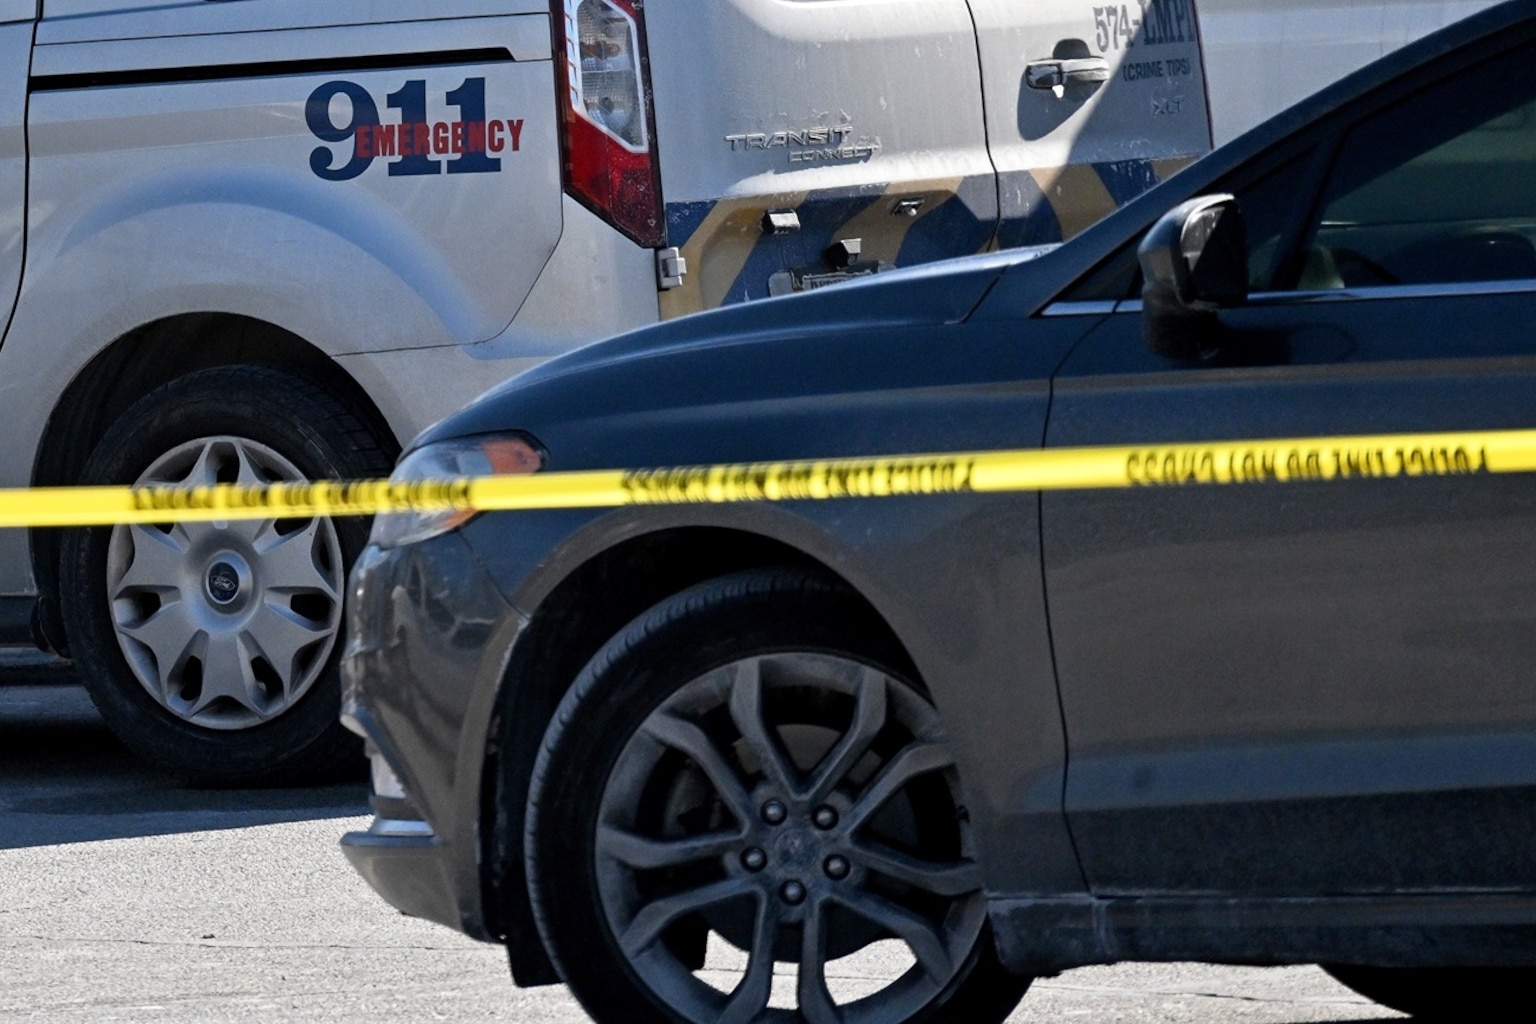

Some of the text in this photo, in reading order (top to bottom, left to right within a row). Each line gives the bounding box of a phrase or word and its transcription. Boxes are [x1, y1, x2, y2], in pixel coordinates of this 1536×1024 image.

[305, 77, 501, 181] 911
[356, 119, 524, 158] EMERGENCY
[725, 126, 853, 151] TRANSIT
[788, 145, 881, 163] CONNECT
